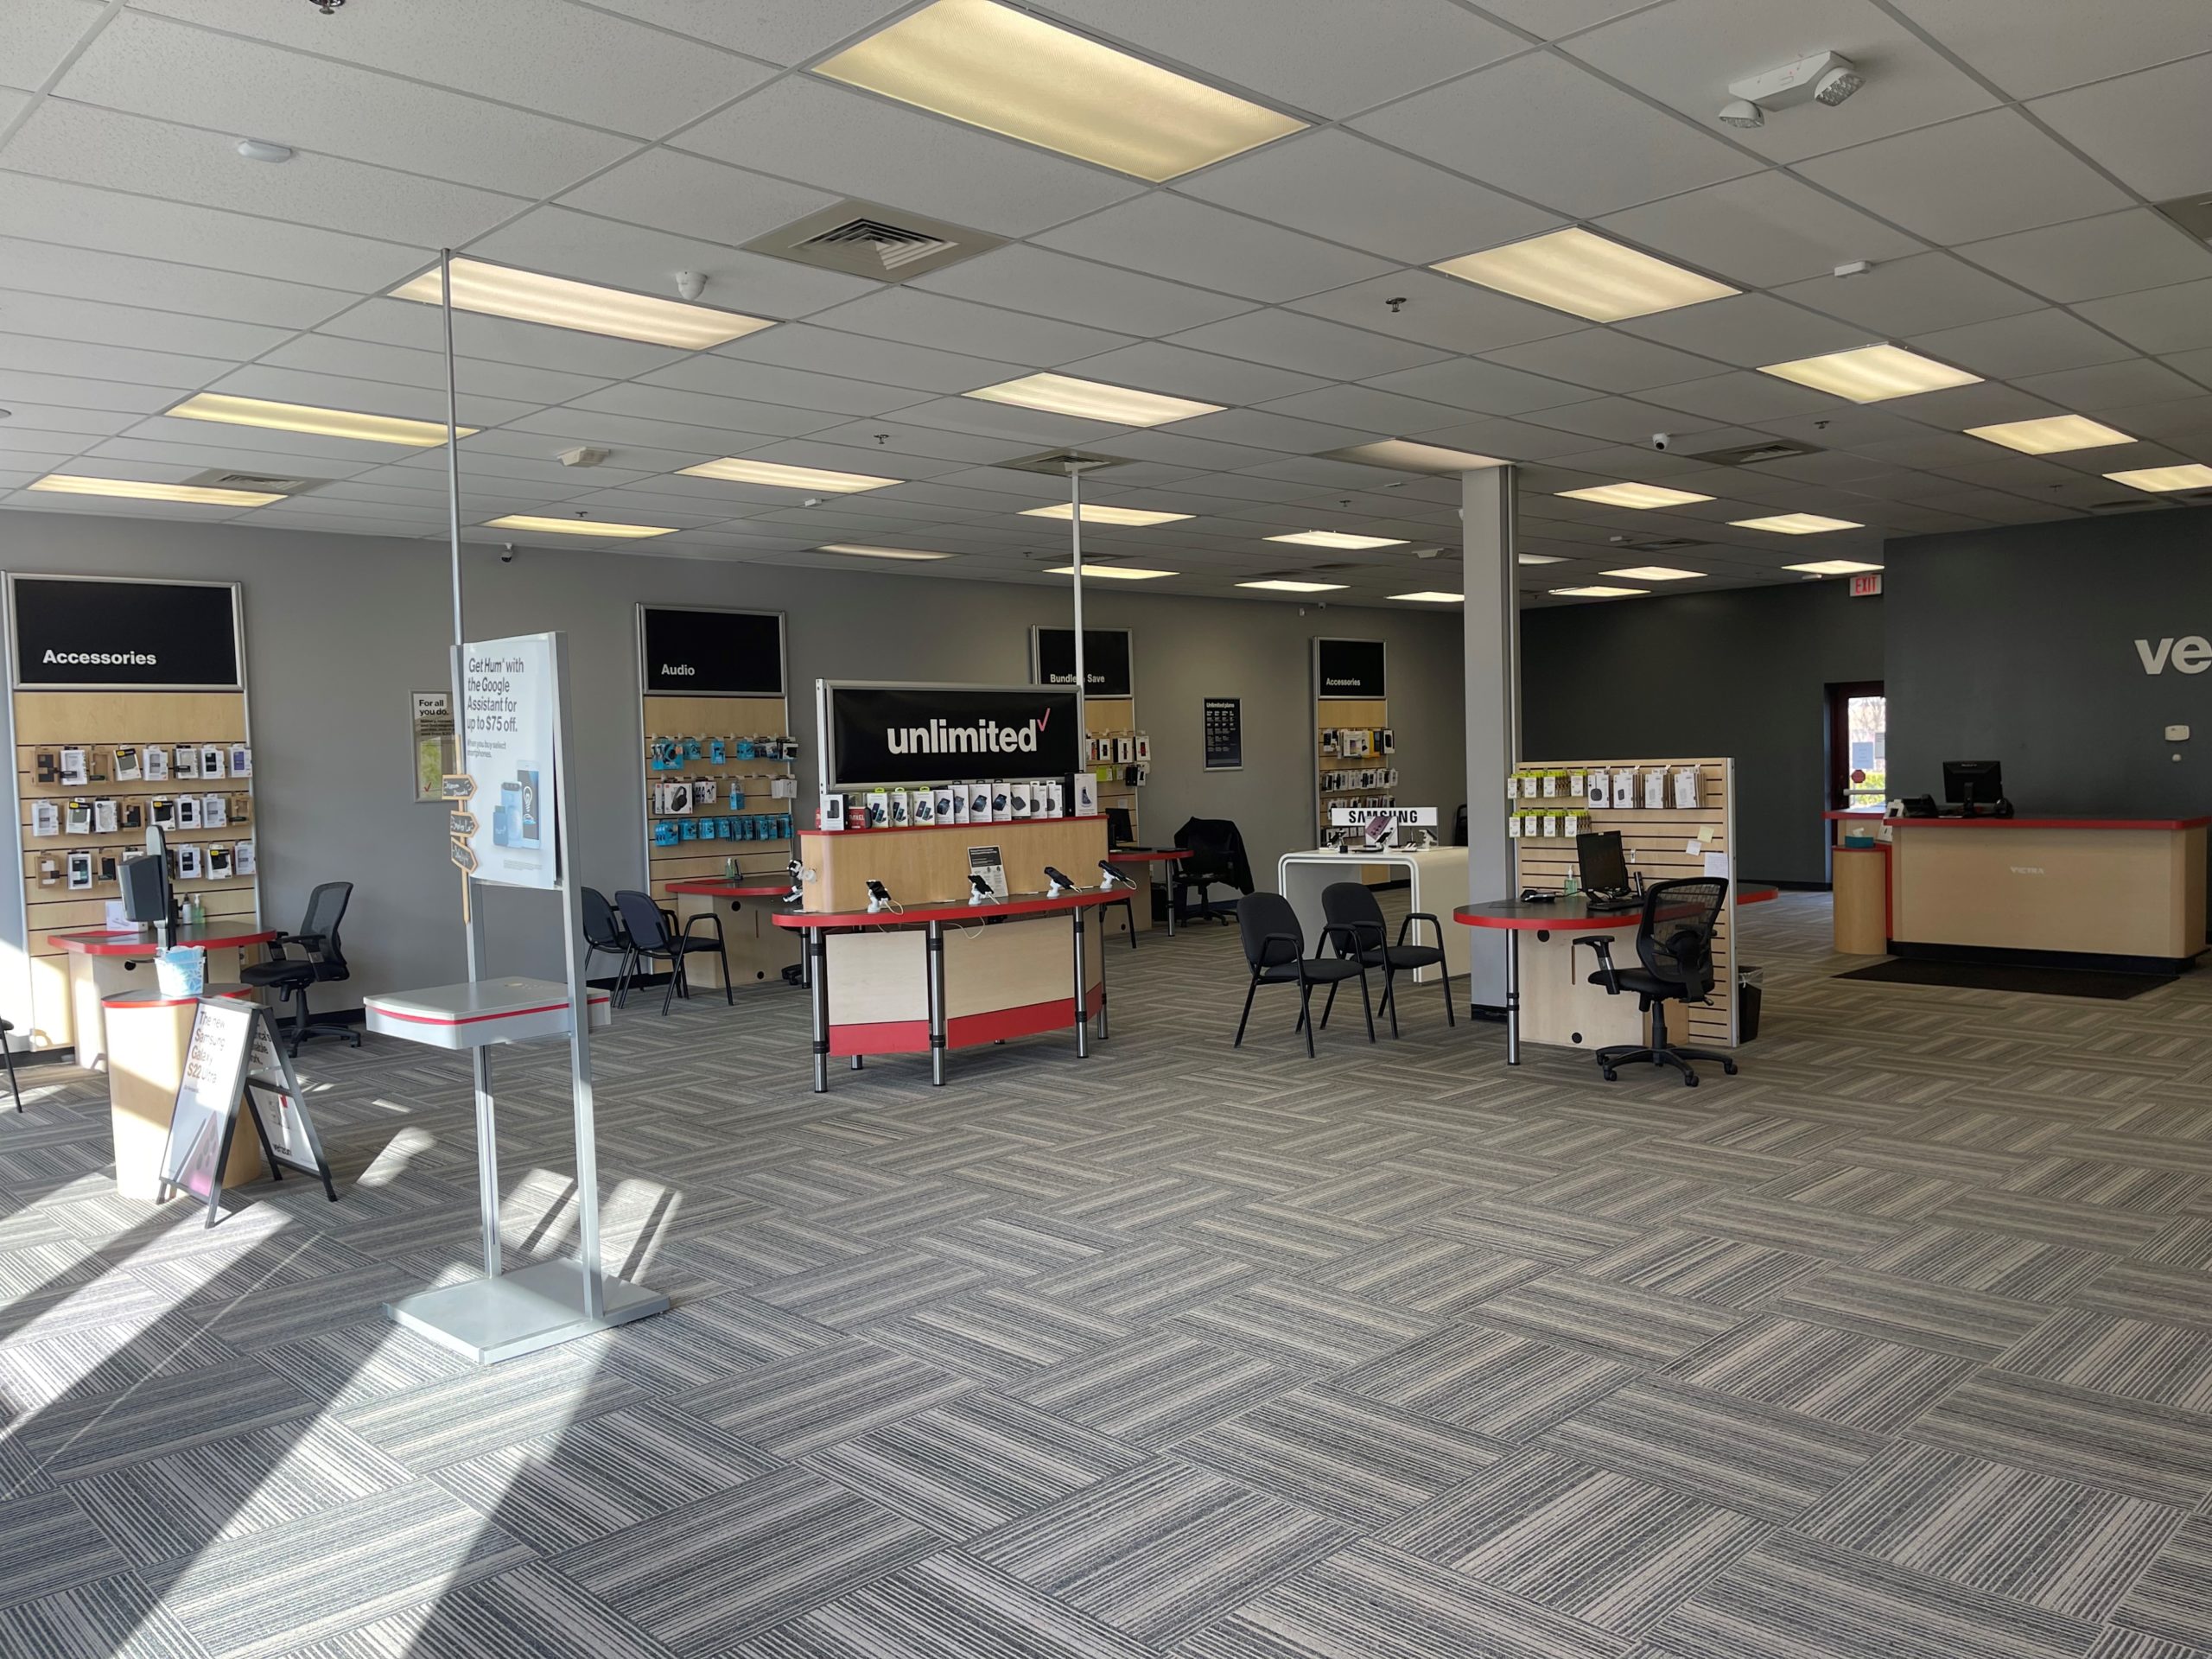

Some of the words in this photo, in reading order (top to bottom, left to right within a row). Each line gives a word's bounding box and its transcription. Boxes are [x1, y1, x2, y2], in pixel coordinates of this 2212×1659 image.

[1855, 576, 1878, 594] EXIT
[42, 649, 157, 664] Accessories
[2133, 635, 2212, 675] ve
[468, 658, 484, 673] Get
[505, 658, 524, 673] with
[661, 664, 696, 676] Audio
[467, 677, 480, 692] the
[481, 677, 510, 696] Google
[1050, 673, 1077, 683] Bundle
[1087, 673, 1105, 683] Save
[1325, 677, 1361, 686] Accessories
[467, 695, 503, 712] Assistant
[505, 696, 518, 712] for
[467, 718, 476, 732] up
[476, 715, 485, 730] to
[486, 715, 502, 731] $75
[503, 717, 518, 732] off.
[887, 719, 1037, 754] unlimited
[200, 1010, 212, 1027] The
[213, 1017, 226, 1028] new
[194, 1028, 226, 1051] Samsung
[191, 1045, 213, 1065] Galaxy
[187, 1062, 202, 1079] S22
